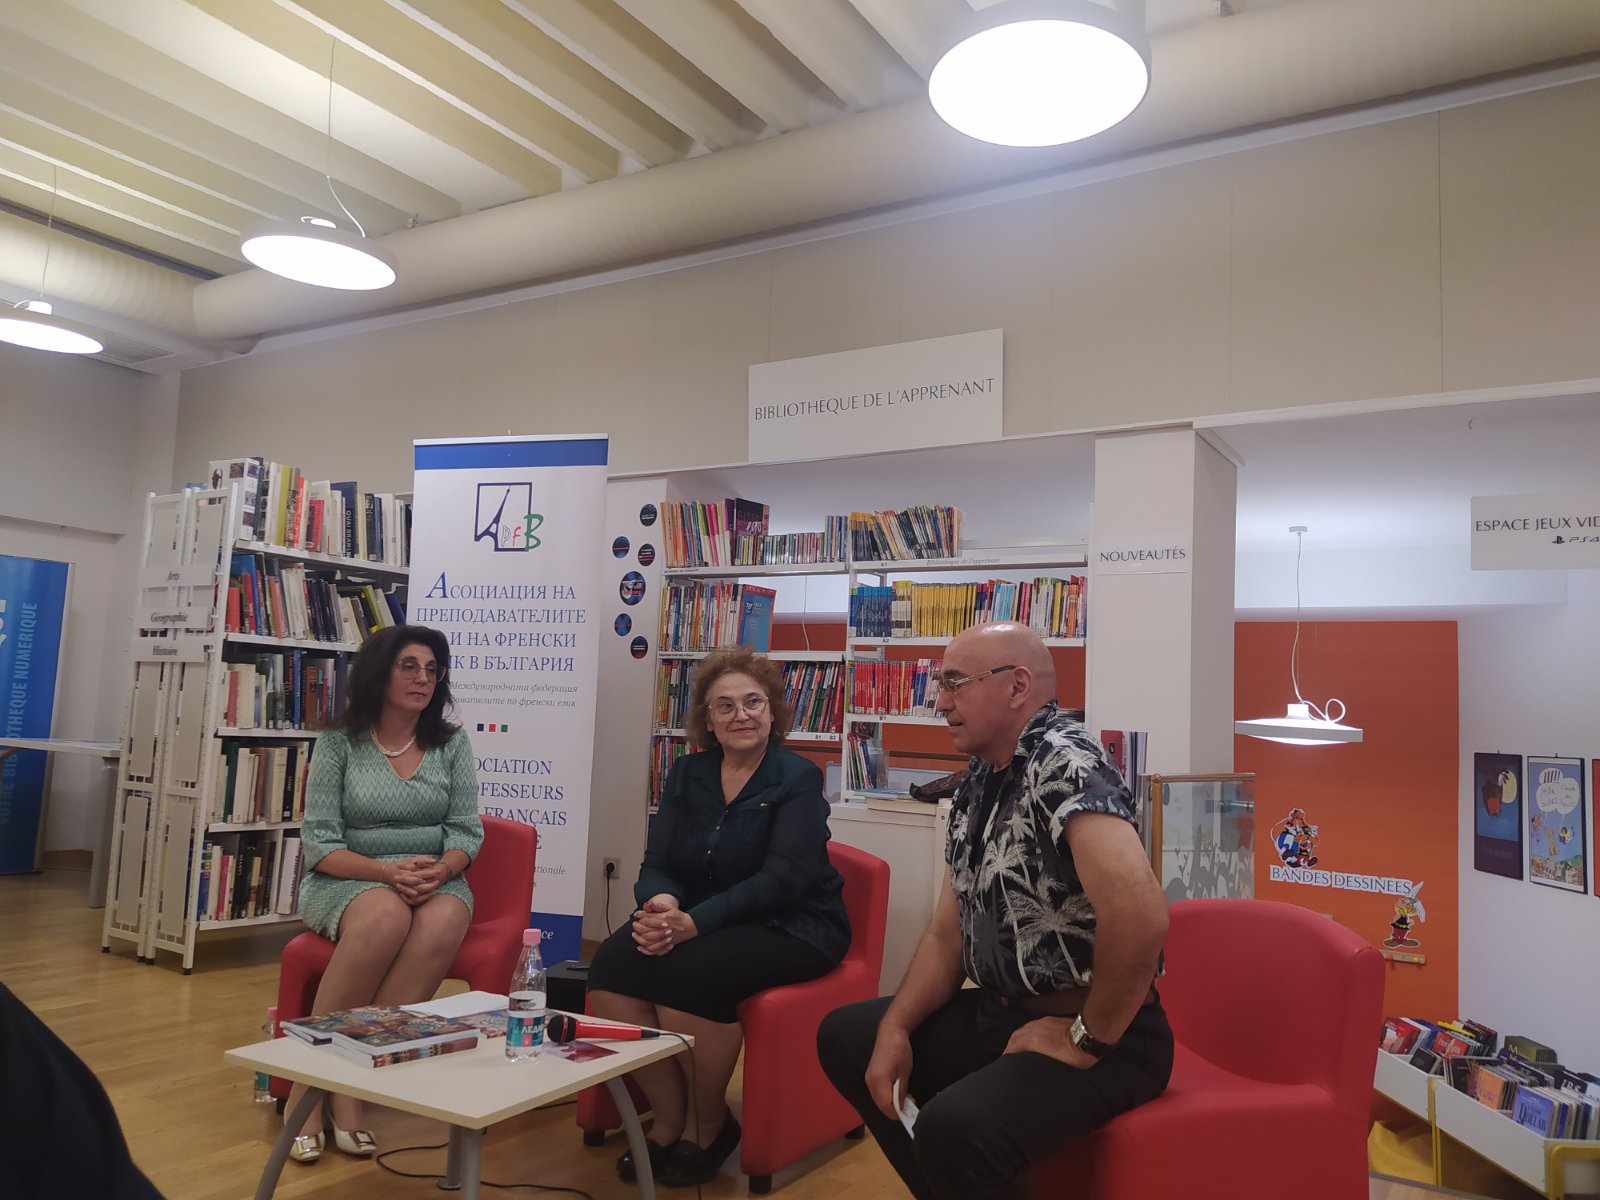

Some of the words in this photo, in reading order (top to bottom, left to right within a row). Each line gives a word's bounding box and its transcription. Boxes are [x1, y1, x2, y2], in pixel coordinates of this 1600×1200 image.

[755, 395, 859, 421] BIBLIOTHEQUE
[863, 392, 883, 408] DE
[887, 378, 995, 405] L'APPRENANT
[1475, 518, 1530, 532] ESPACE
[1536, 517, 1571, 531] JEUX
[1100, 546, 1186, 562] NOUVEAUTÉS
[553, 585, 576, 600] НА
[416, 608, 586, 624] ПРЕПОДАВАТЕЛИТЕ
[14, 602, 38, 680] NUMERIQUE
[450, 632, 462, 646] И
[467, 632, 490, 646] НА
[494, 632, 577, 648] ФРЕНСКИ
[469, 655, 479, 670] В
[484, 656, 574, 672] БЪЛГАРИЯ
[530, 684, 578, 694] федерация
[519, 698, 555, 708] френски
[472, 757, 552, 775] OCIATION
[484, 806, 567, 828] FRANÇAIS
[1272, 867, 1330, 885] BANDES
[1334, 873, 1412, 895] DESSINEES
